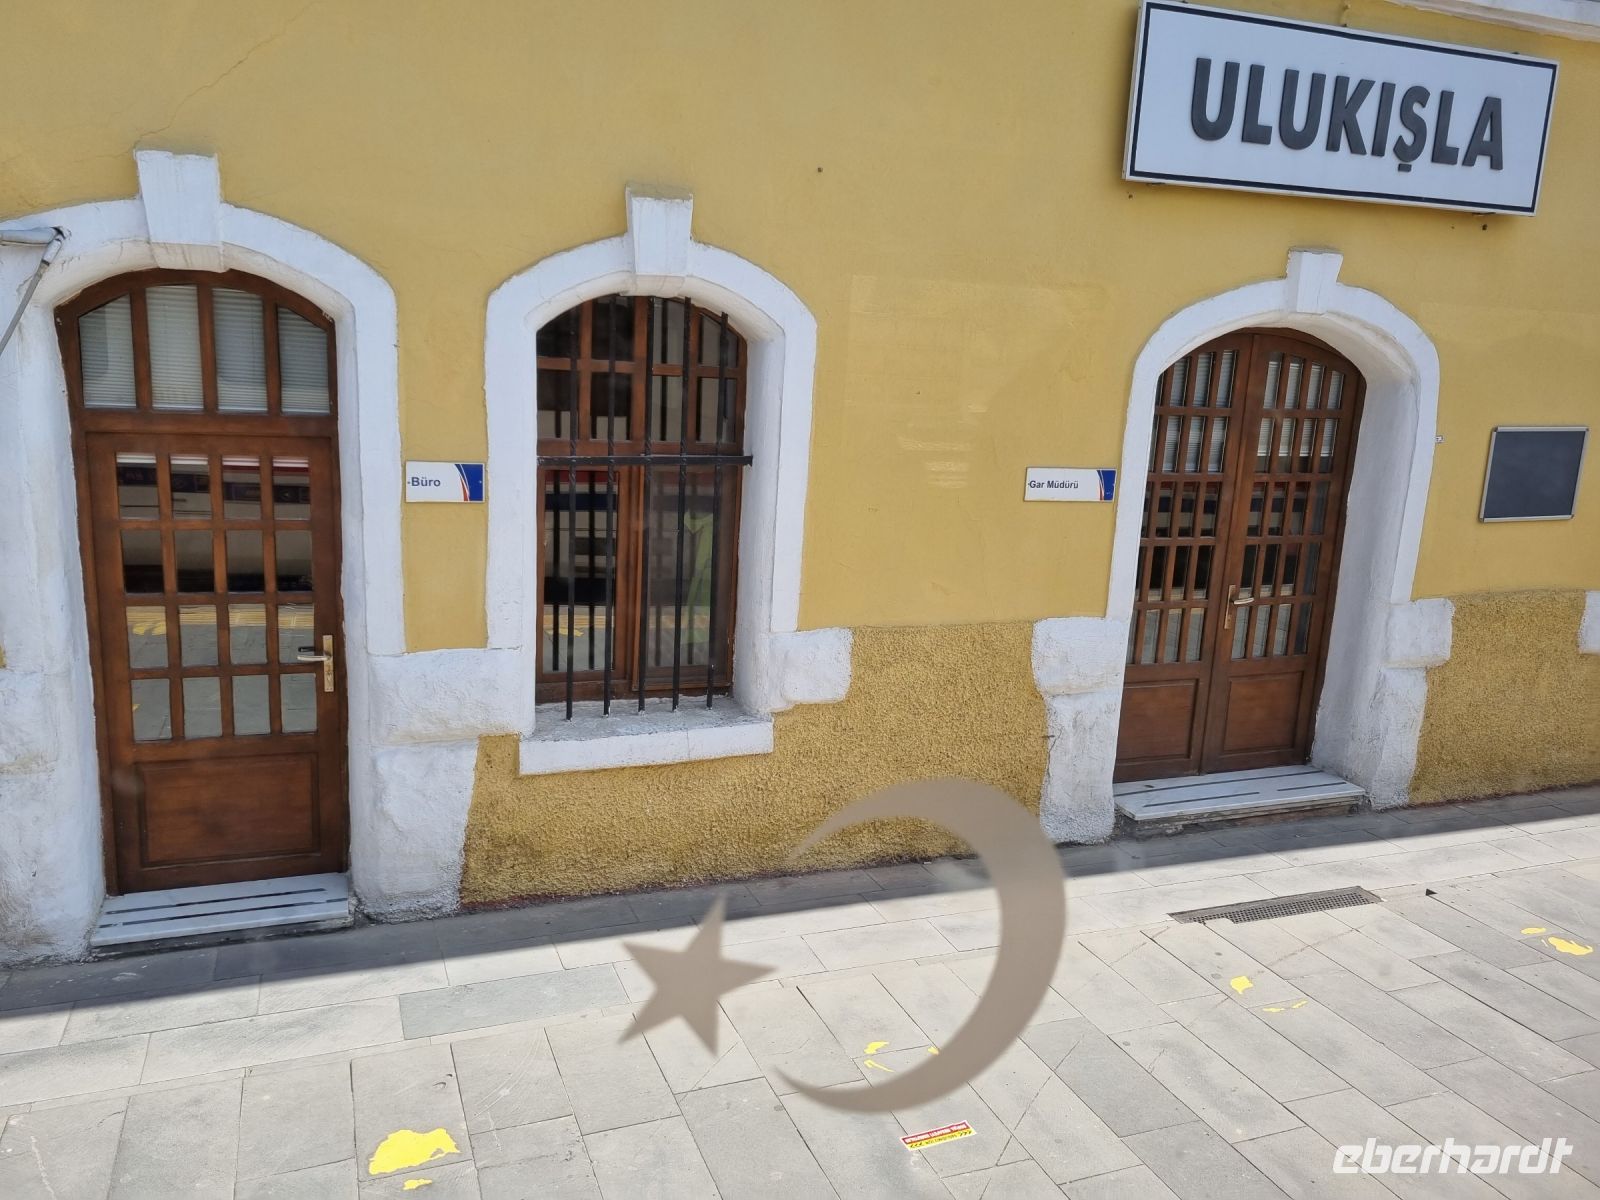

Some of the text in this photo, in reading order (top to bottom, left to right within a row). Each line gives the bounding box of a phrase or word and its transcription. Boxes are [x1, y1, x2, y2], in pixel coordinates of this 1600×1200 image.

[1190, 57, 1504, 172] ULUKIŞLA
[411, 476, 441, 487] Büro
[1029, 480, 1079, 489] Gar Müdürü
